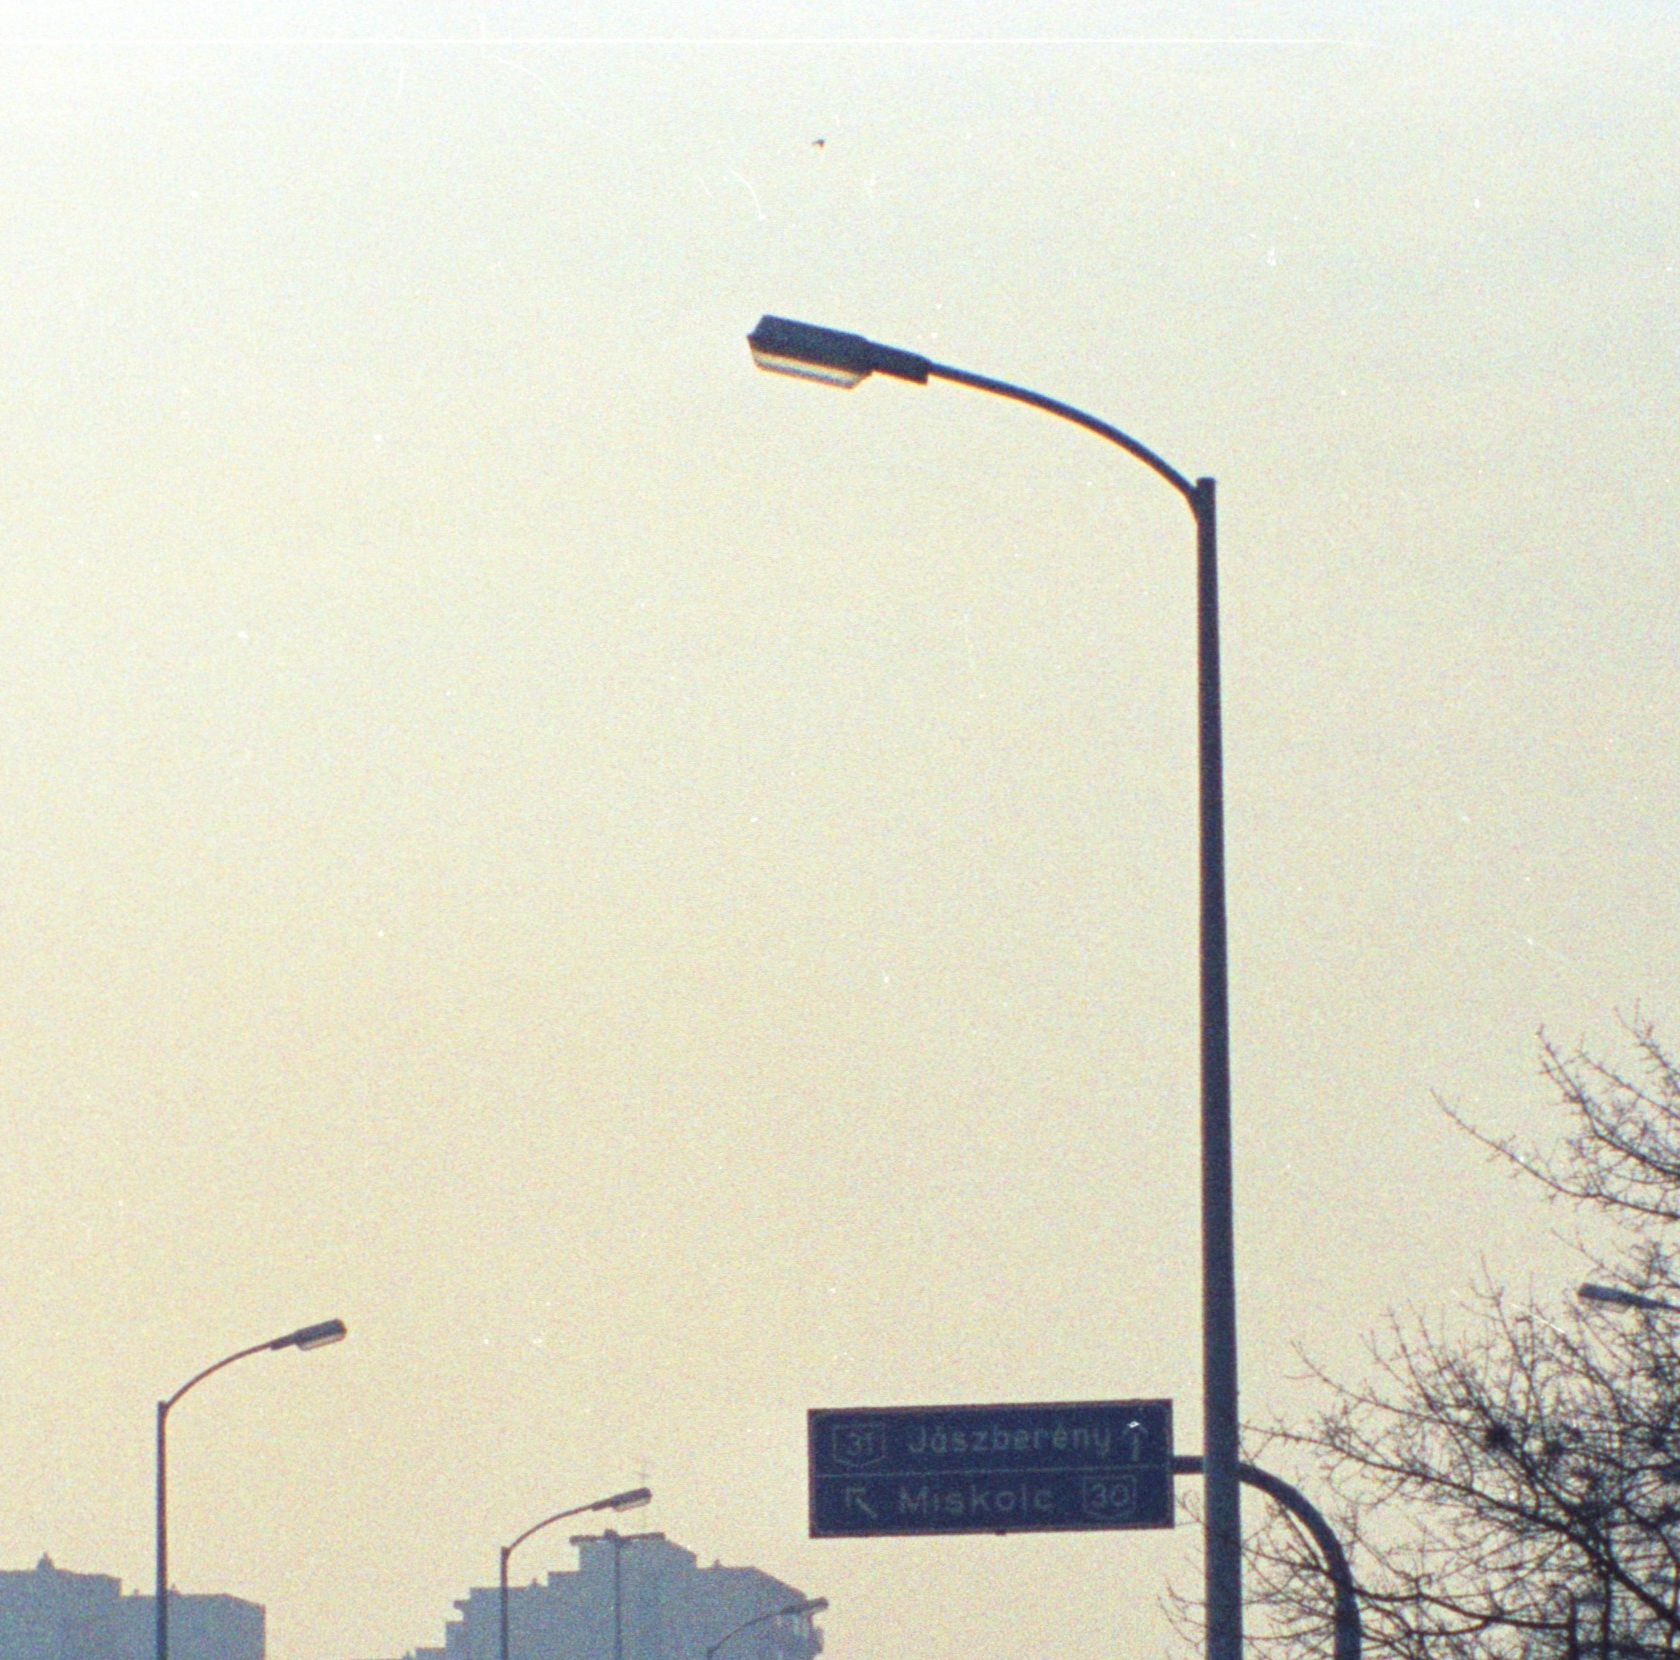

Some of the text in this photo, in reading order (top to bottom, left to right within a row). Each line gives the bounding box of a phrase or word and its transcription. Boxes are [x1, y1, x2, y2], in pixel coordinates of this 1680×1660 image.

[845, 1423, 1111, 1457] 31 Jászberény
[898, 1482, 1129, 1514] Miskolc 30
